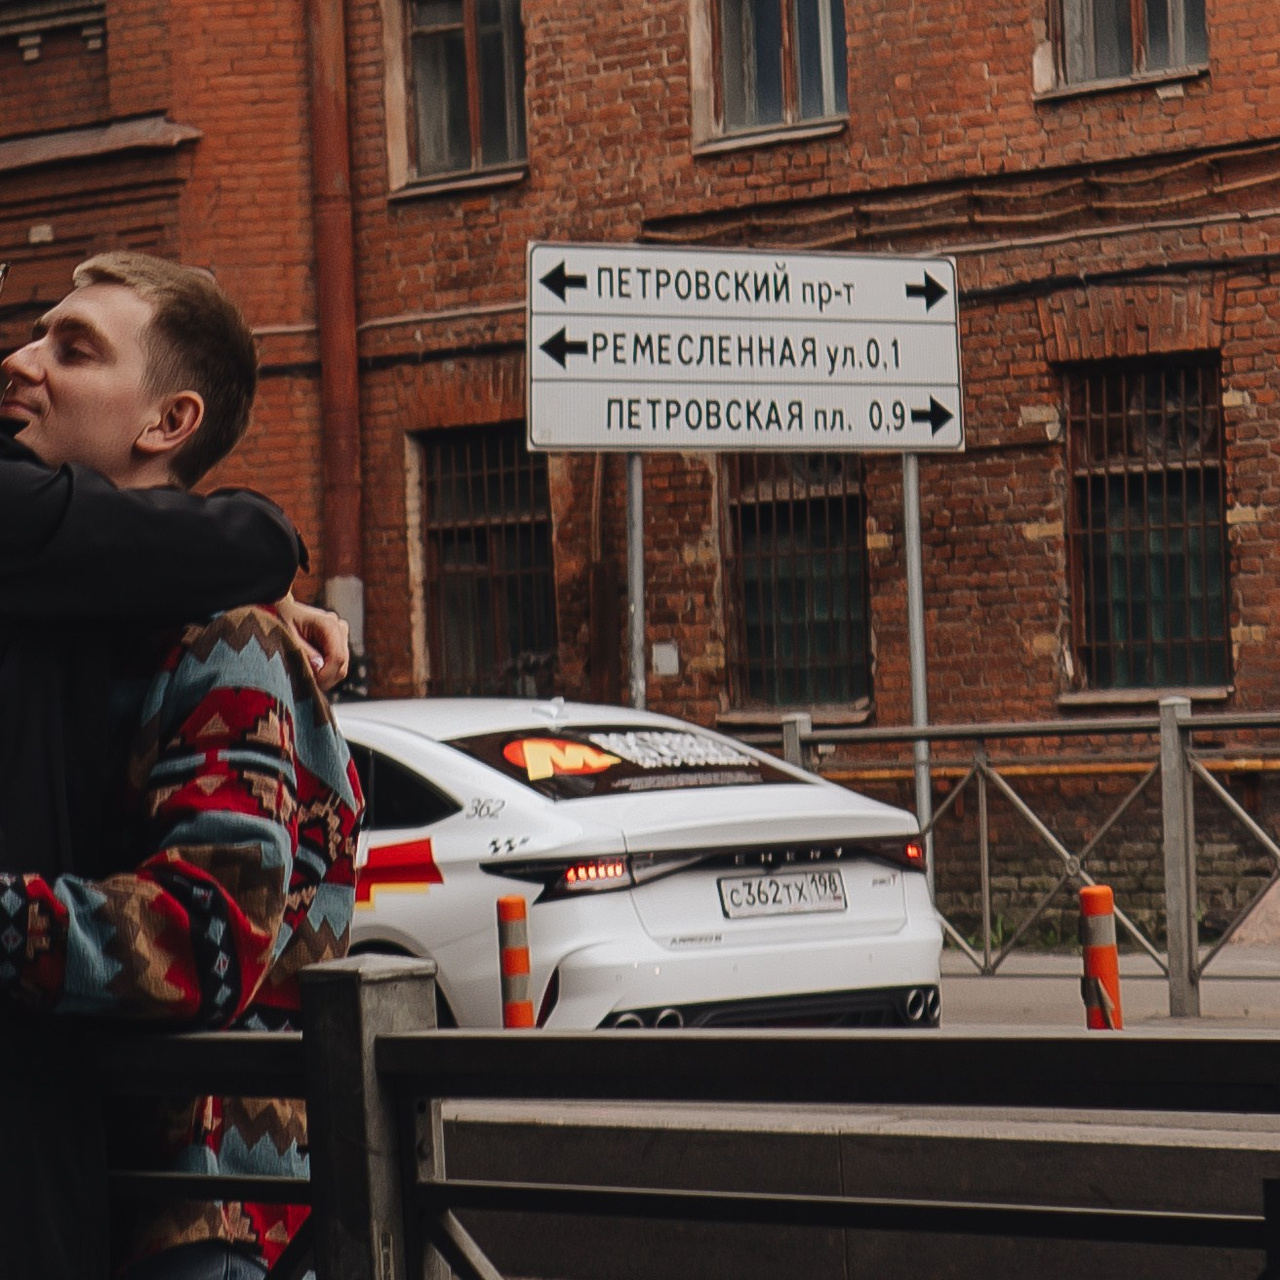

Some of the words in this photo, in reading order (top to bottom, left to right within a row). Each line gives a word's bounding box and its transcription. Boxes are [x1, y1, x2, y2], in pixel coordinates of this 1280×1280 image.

[597, 261, 790, 302] ПЕТРОВСКИЙ
[802, 281, 854, 313] пр-т
[592, 332, 817, 368] РЕМЕСЛЕННАЯ
[607, 398, 803, 431] ПЕТРОВСКАЯ
[814, 408, 852, 432] пл.
[466, 798, 505, 819] 362
